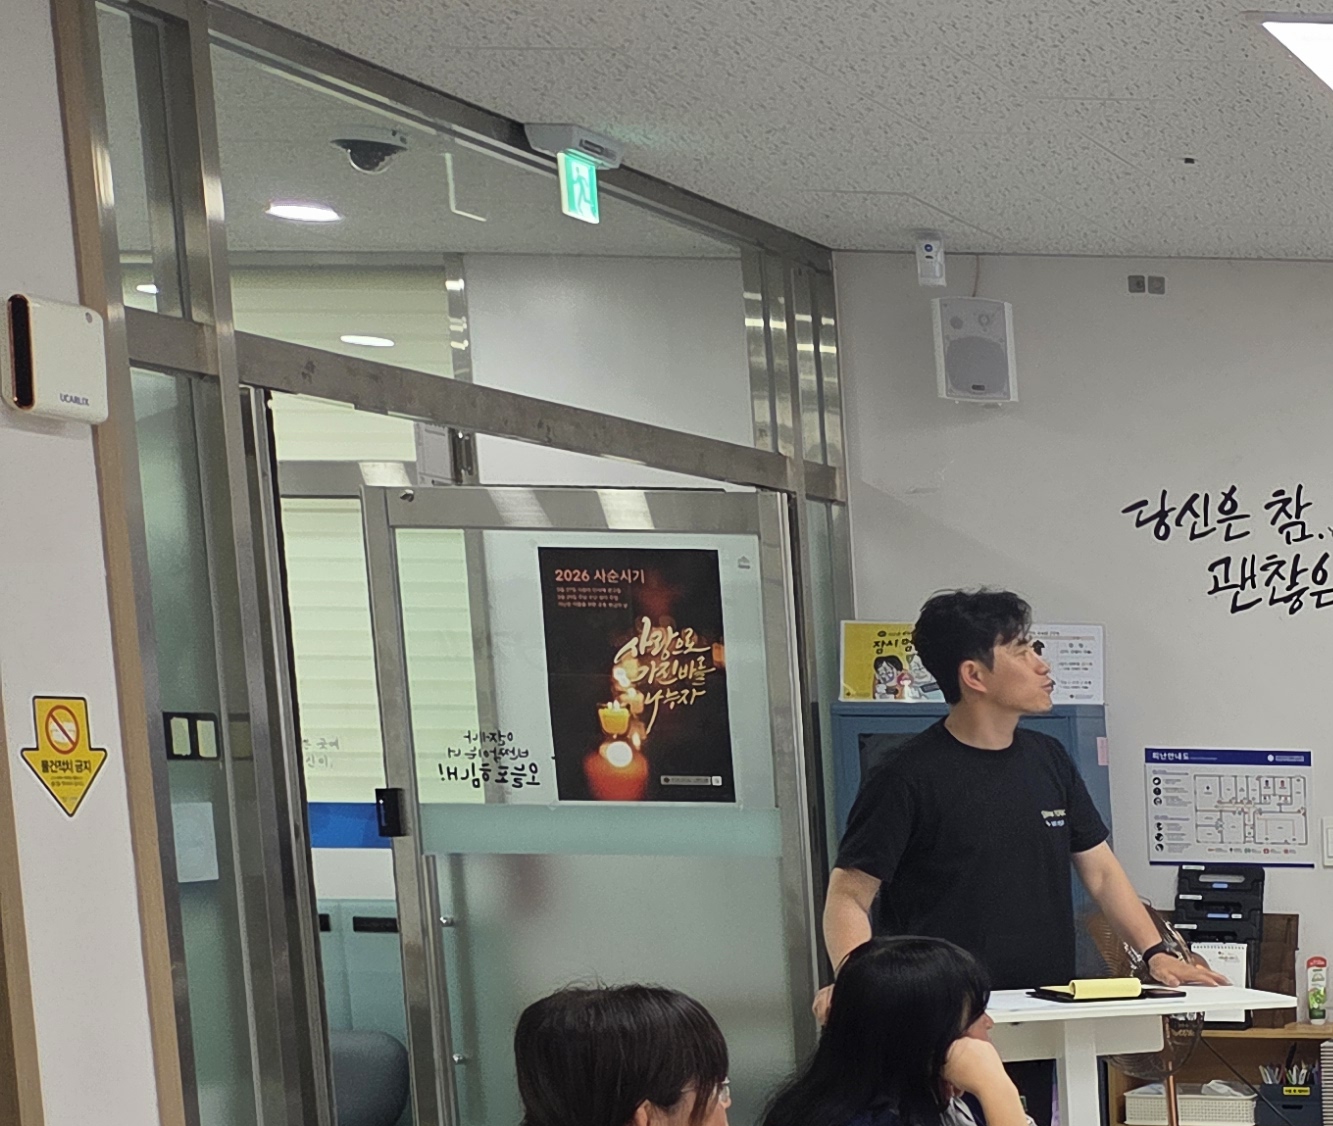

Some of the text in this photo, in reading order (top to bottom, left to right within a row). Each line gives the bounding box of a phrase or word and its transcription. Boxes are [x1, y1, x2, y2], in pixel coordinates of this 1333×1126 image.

[1121, 483, 1325, 545] 당신은 참.
[555, 568, 645, 584] 2026 사순시기
[614, 616, 711, 664] 사랑으로
[645, 689, 706, 735] 나누자
[75, 760, 92, 773] 금지
